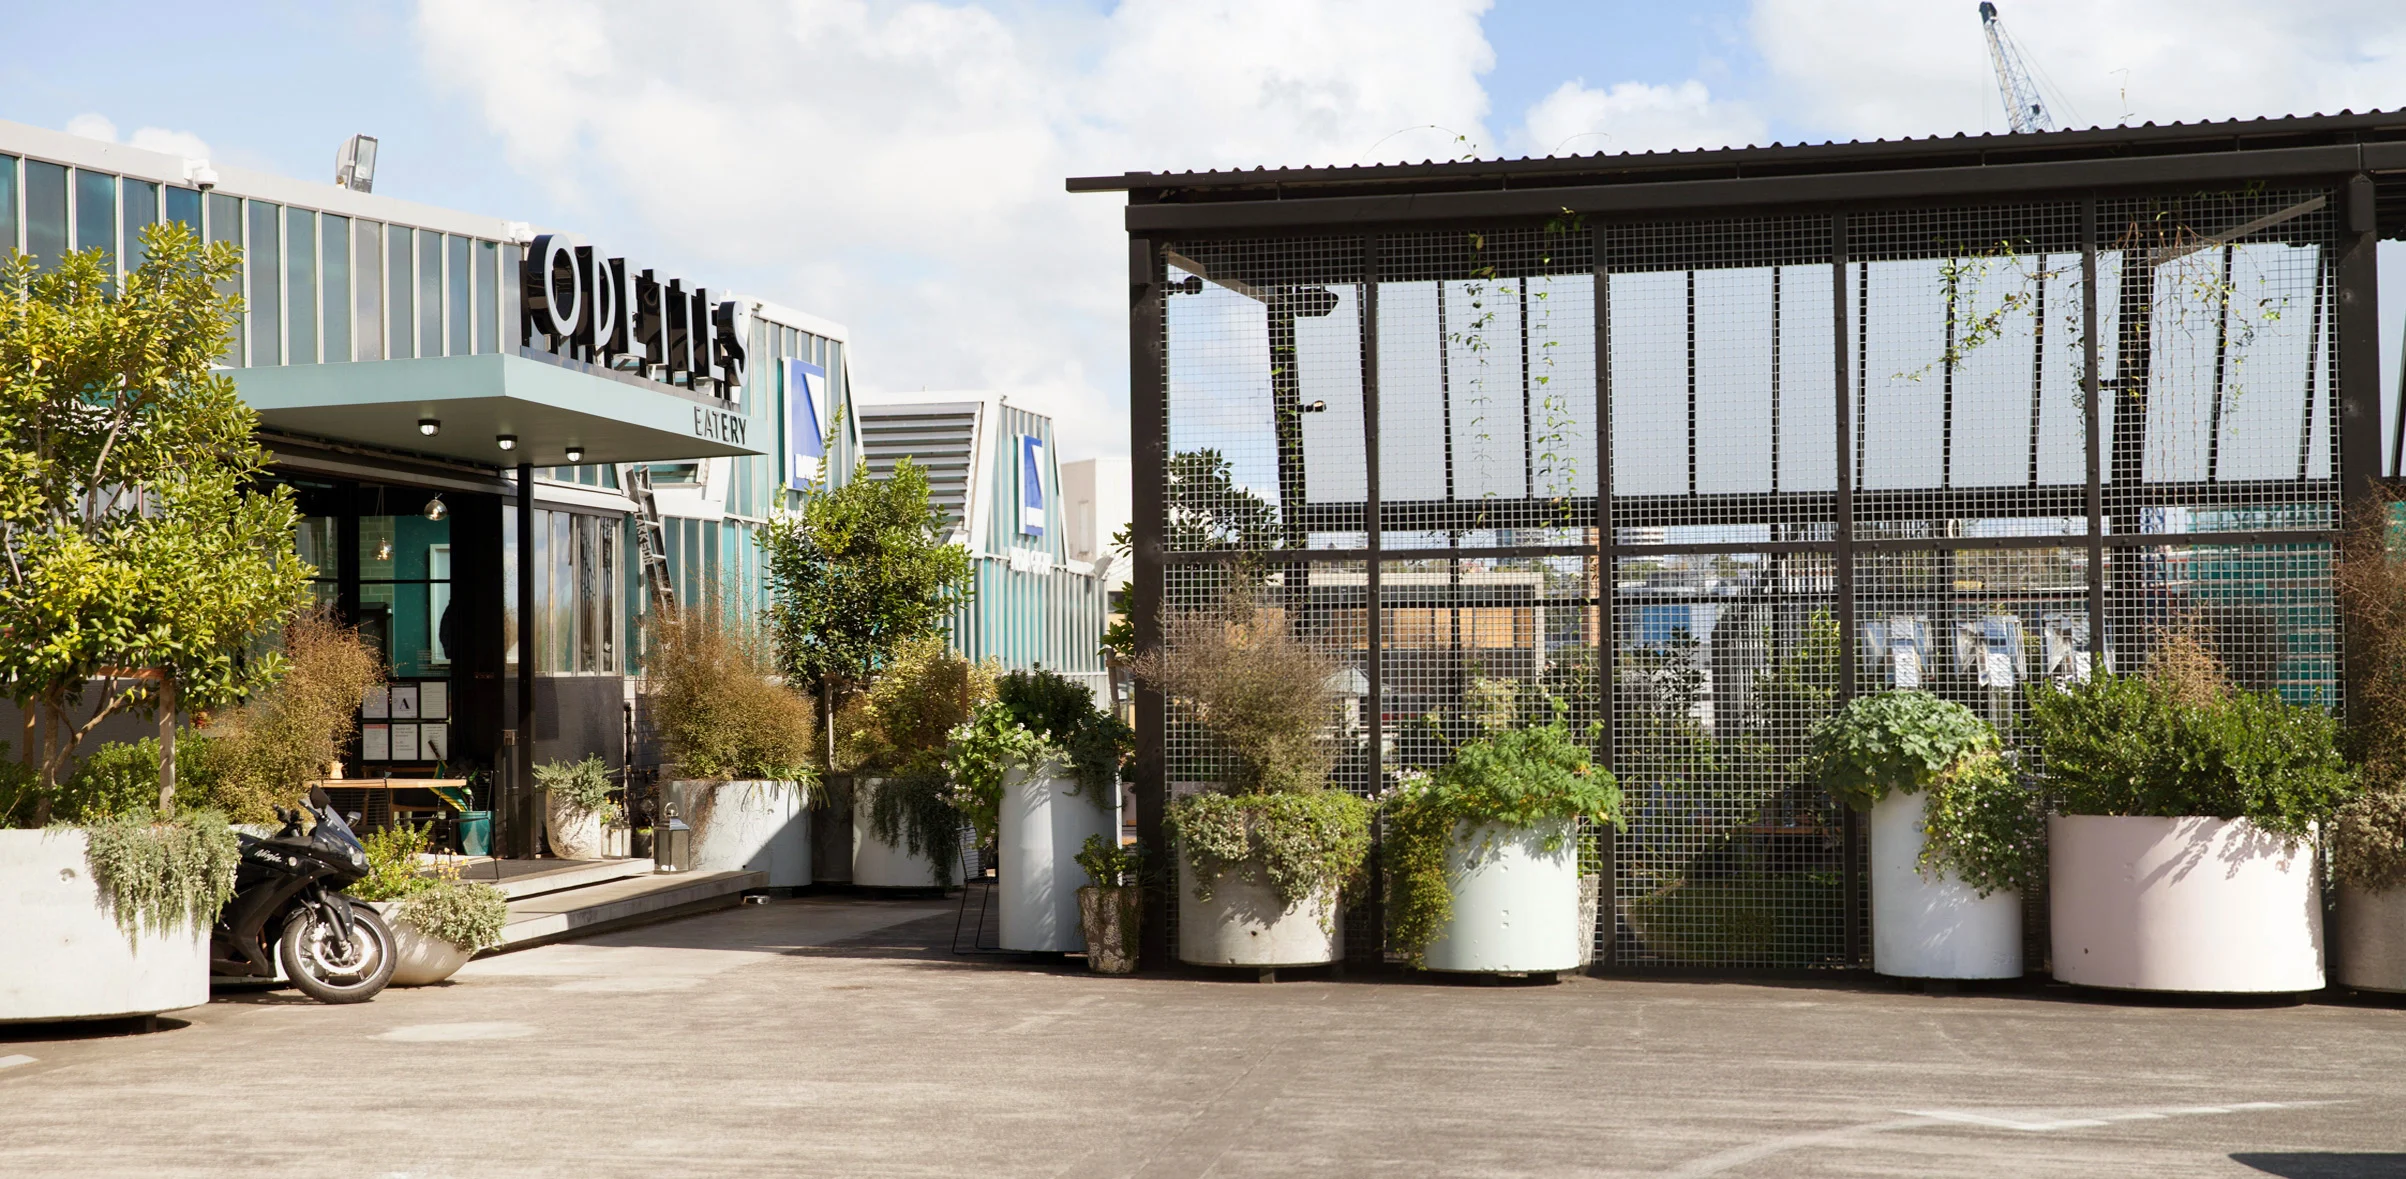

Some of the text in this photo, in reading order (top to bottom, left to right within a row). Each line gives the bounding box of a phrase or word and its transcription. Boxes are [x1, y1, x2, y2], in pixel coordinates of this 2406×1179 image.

[529, 233, 750, 388] ODETTES
[693, 405, 748, 446] EATERY
[399, 697, 410, 709] A
[253, 848, 283, 863] Ninja
